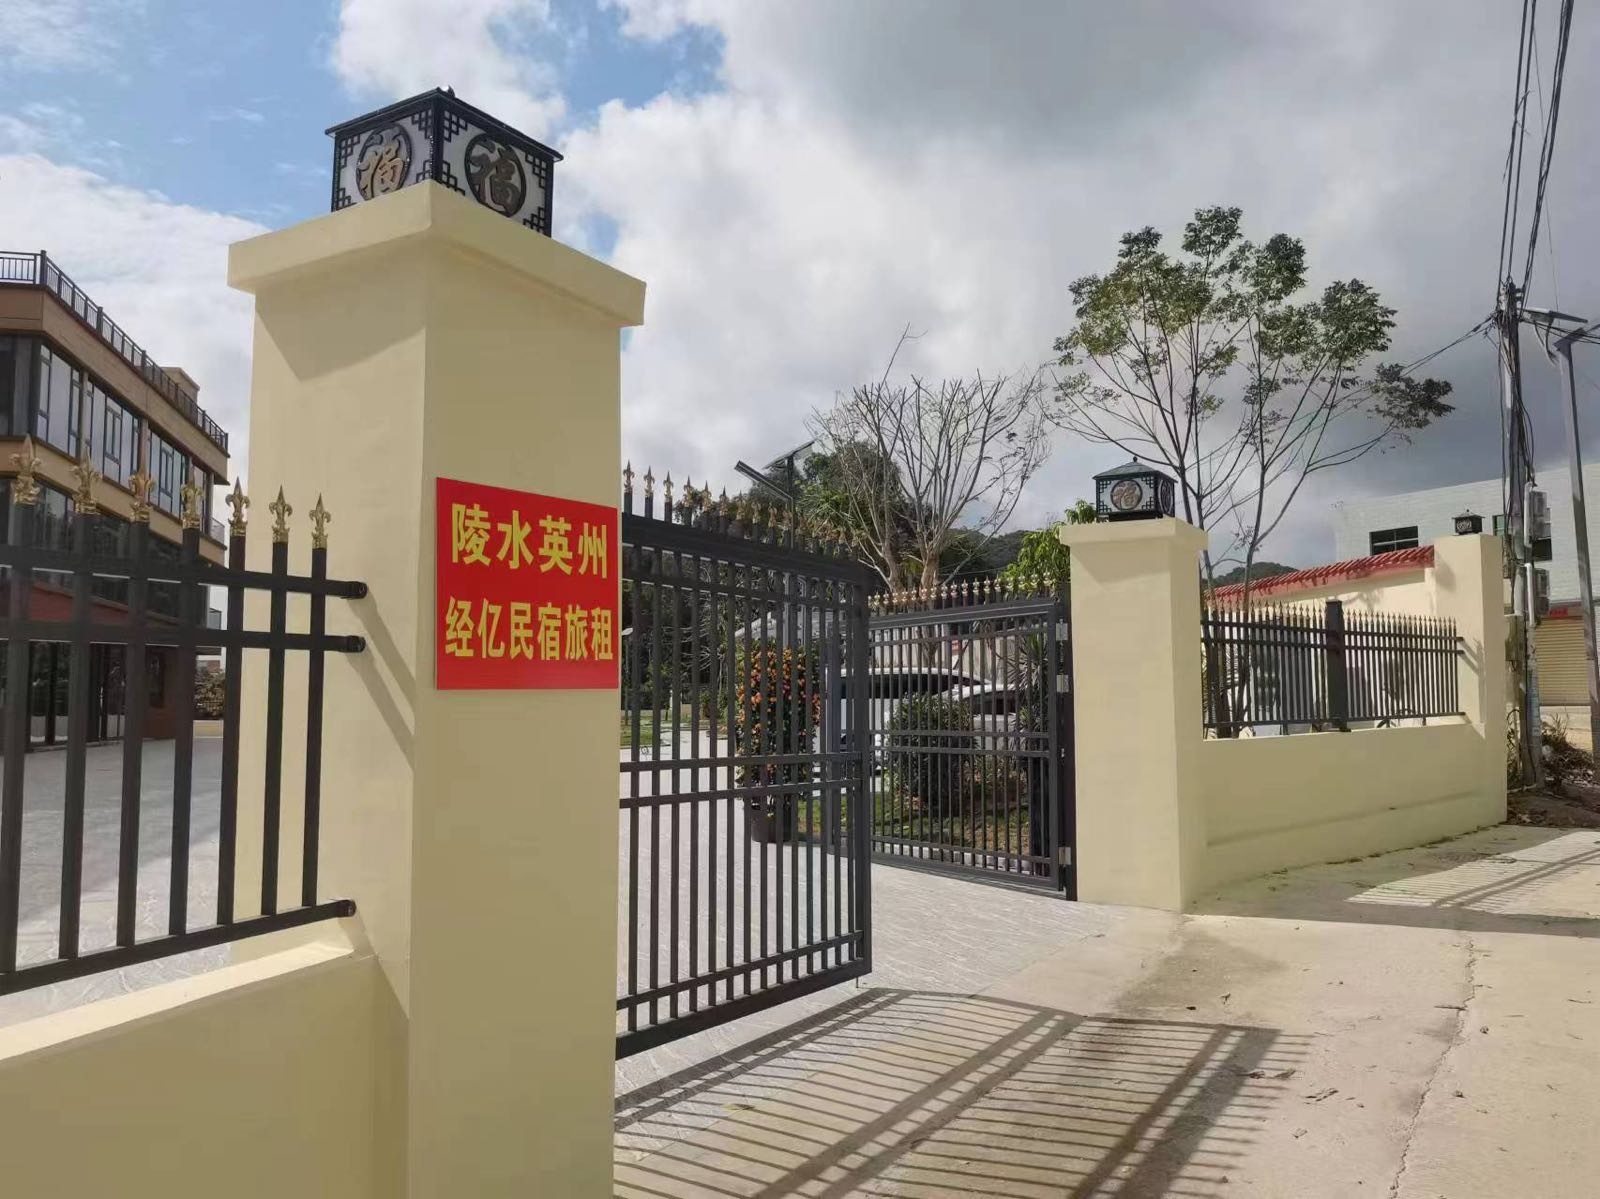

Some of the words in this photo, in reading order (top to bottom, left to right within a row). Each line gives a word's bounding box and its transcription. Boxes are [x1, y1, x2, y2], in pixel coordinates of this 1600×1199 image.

[451, 503, 608, 579] 陵水英州
[445, 596, 613, 661] 经亿民宿旅租
